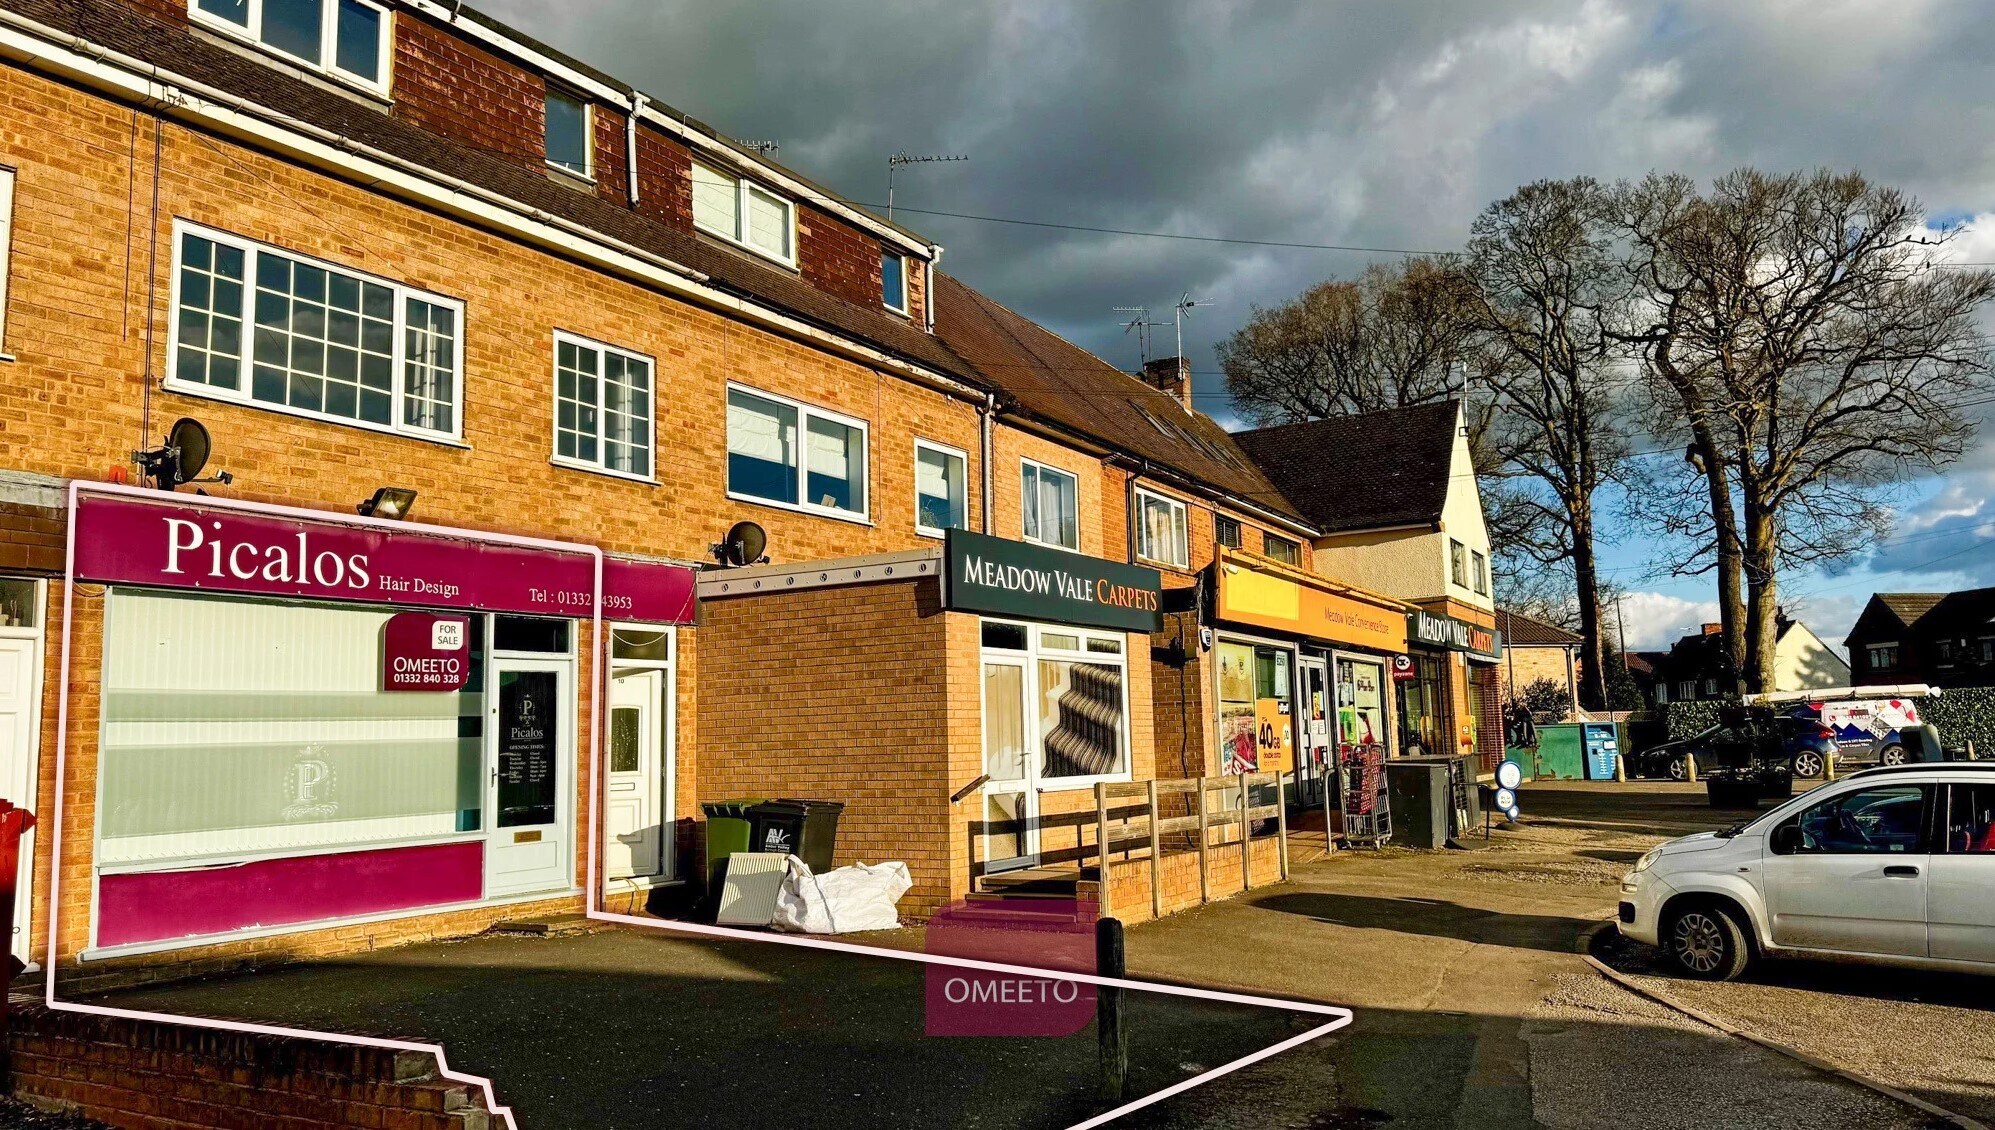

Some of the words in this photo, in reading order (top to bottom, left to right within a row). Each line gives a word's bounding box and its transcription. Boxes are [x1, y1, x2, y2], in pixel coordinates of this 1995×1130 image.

[160, 517, 371, 589] Picalos
[378, 575, 411, 592] Hair
[413, 578, 460, 598] Design
[963, 554, 1051, 595] MEADOW
[1054, 569, 1093, 602] VALE
[1096, 579, 1158, 612] CARPETS
[529, 588, 548, 603] Tel
[558, 591, 591, 606] 01332
[595, 595, 633, 609] 43953
[439, 624, 457, 634] FOR
[1418, 610, 1452, 643] MEADOW
[1451, 620, 1469, 648] VALE
[437, 636, 459, 645] SALE
[393, 656, 460, 673] OMEETO
[393, 673, 421, 683] 01332
[423, 673, 441, 683] 840
[443, 674, 460, 683] 328
[523, 700, 533, 715] P
[511, 727, 544, 738] Picalos
[1259, 723, 1274, 749] 40
